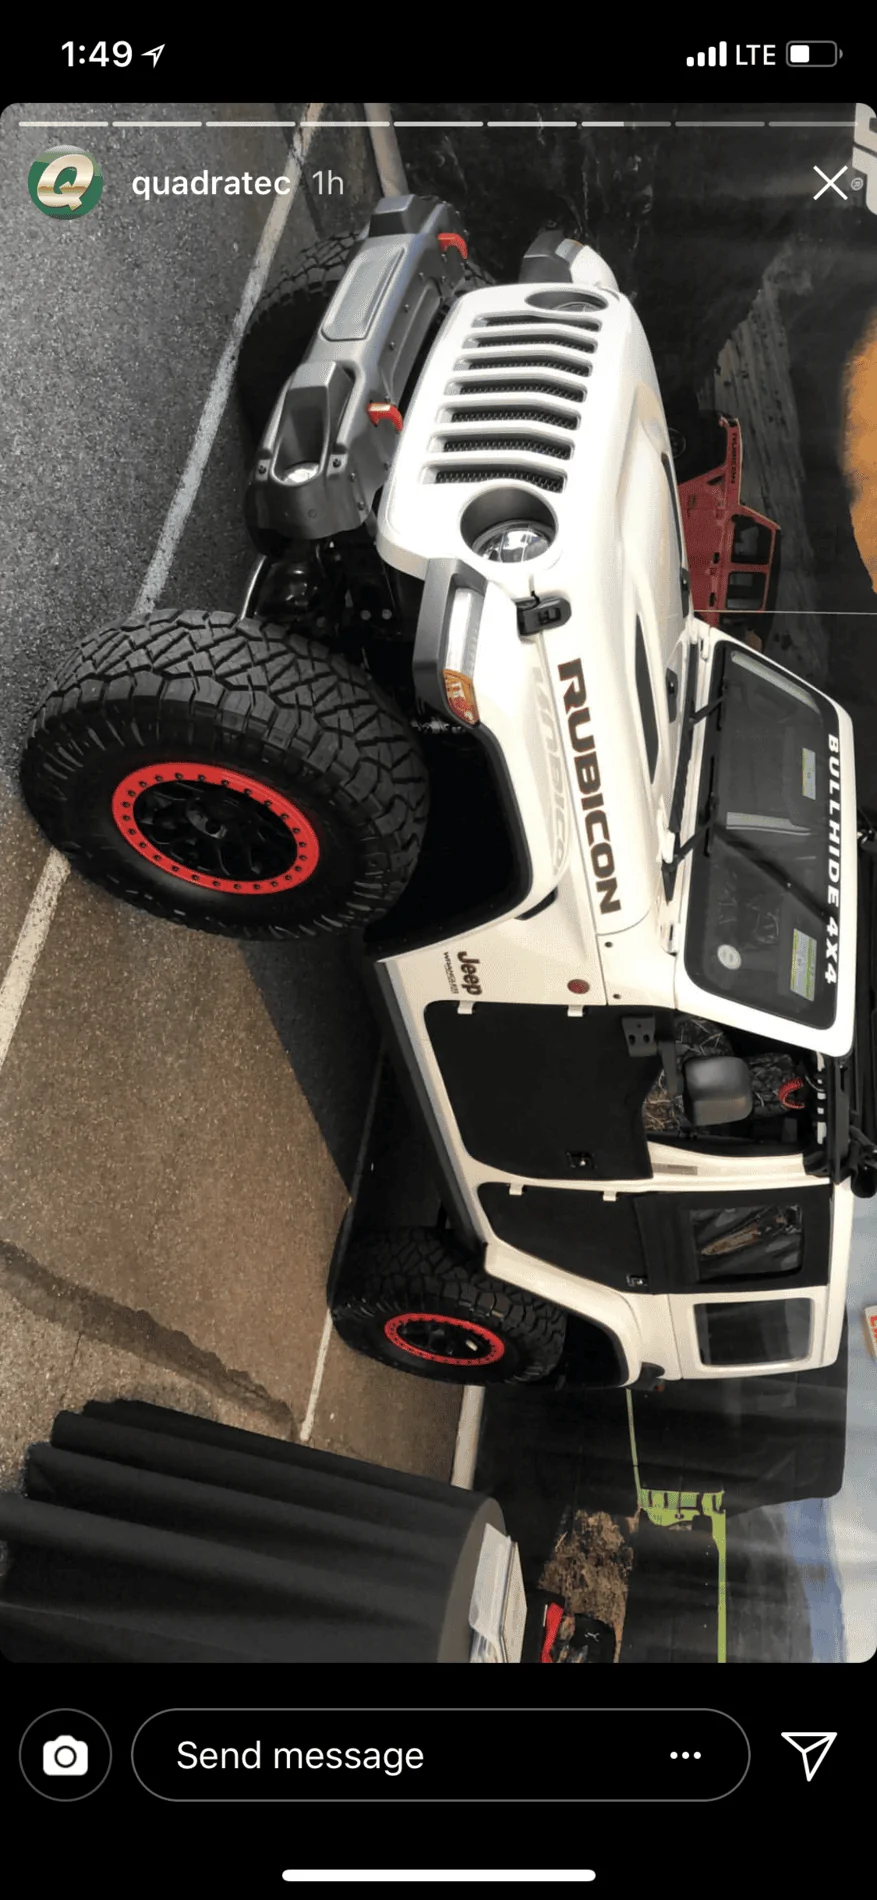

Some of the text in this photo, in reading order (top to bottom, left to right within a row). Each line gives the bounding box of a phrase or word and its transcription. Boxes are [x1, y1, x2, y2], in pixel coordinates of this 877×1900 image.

[557, 658, 622, 915] RUBICON
[824, 733, 841, 985] BULLHIDE 4X4
[457, 951, 482, 995] Jeep
